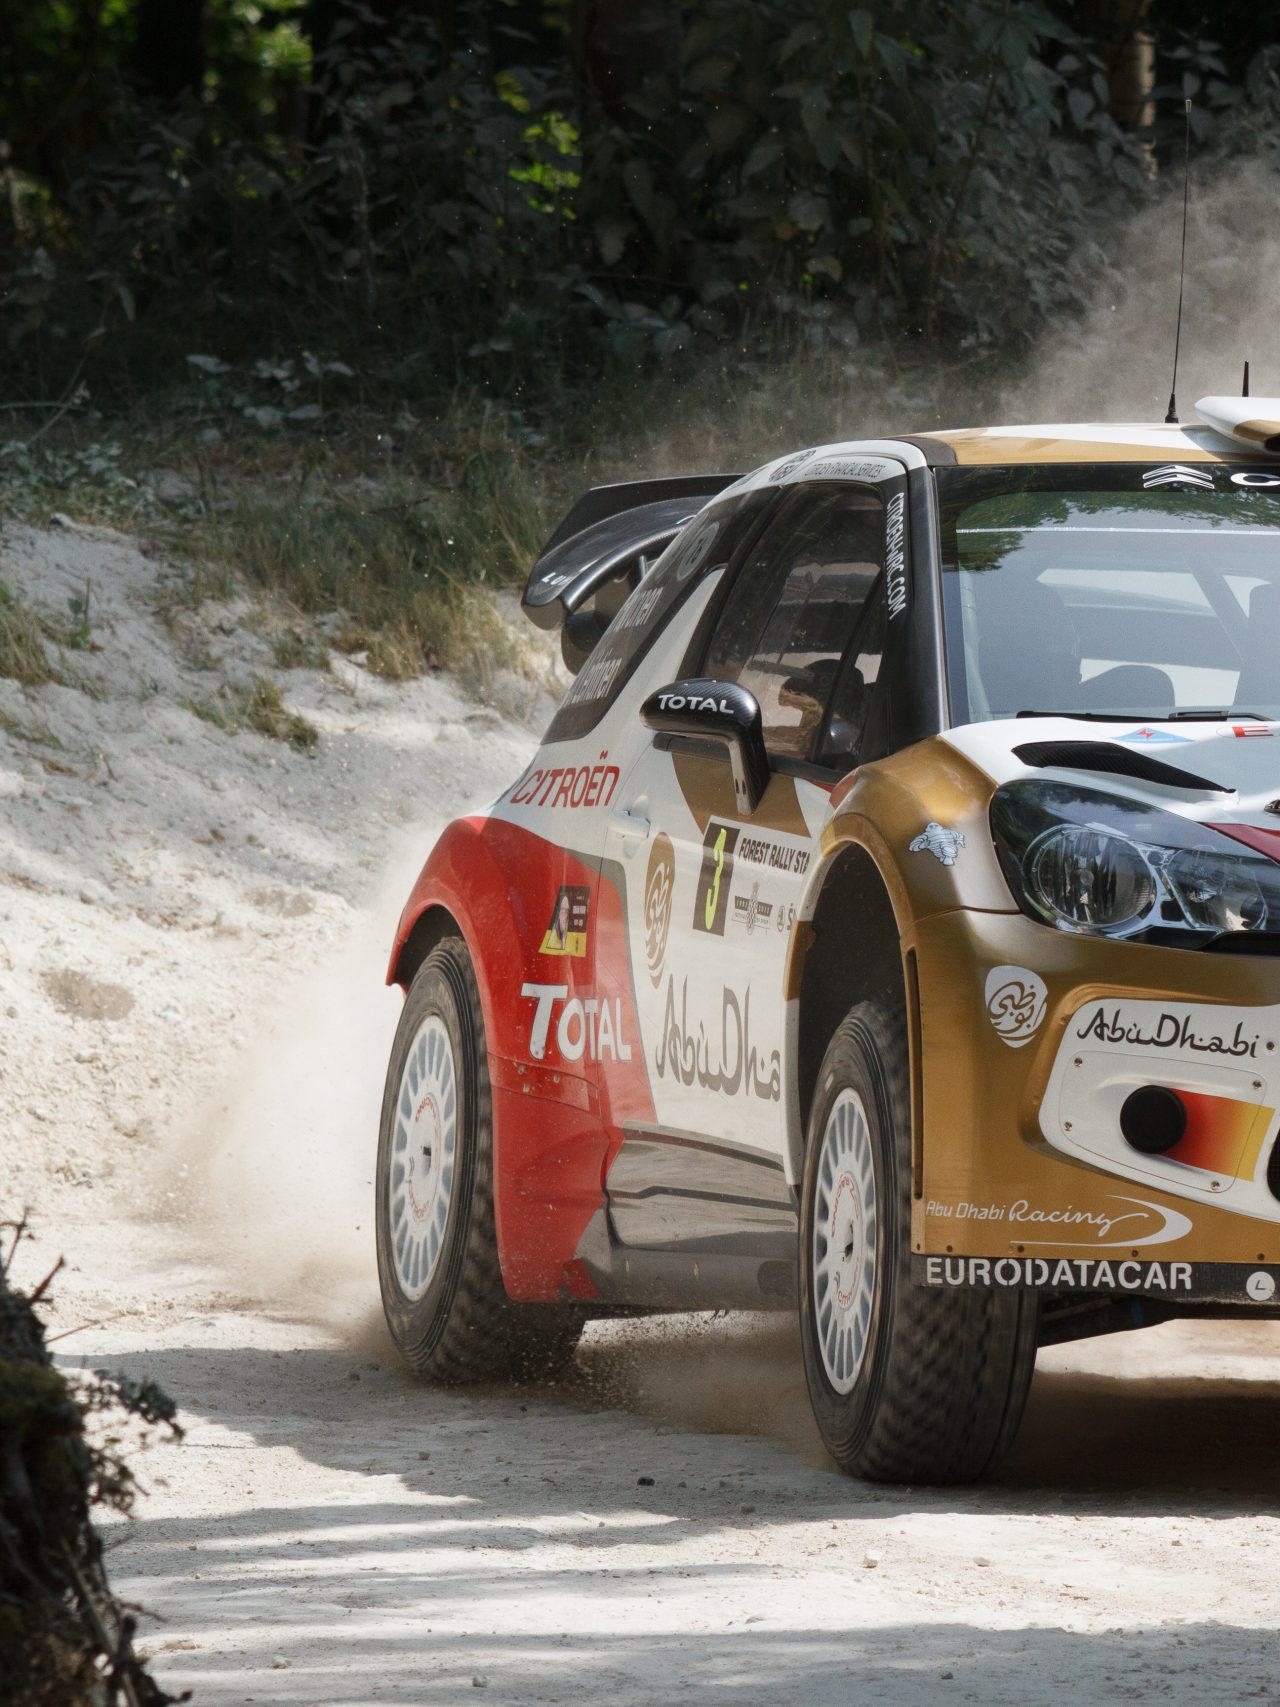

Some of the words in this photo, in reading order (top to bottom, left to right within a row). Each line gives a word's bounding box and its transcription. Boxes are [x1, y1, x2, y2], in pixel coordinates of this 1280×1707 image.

[886, 492, 907, 620] CITROEN-WRC.COM
[658, 693, 734, 714] TOTAL
[510, 750, 620, 808] CITROËN
[739, 837, 770, 865] FOREST
[768, 844, 795, 872] RALLY
[705, 828, 727, 931] 3
[520, 982, 632, 1062] TOTAL
[926, 1201, 952, 1217] Abu
[955, 1202, 1005, 1220] Dhabi
[1008, 1200, 1149, 1237] Racing
[926, 1257, 1193, 1290] EURODATACAR
